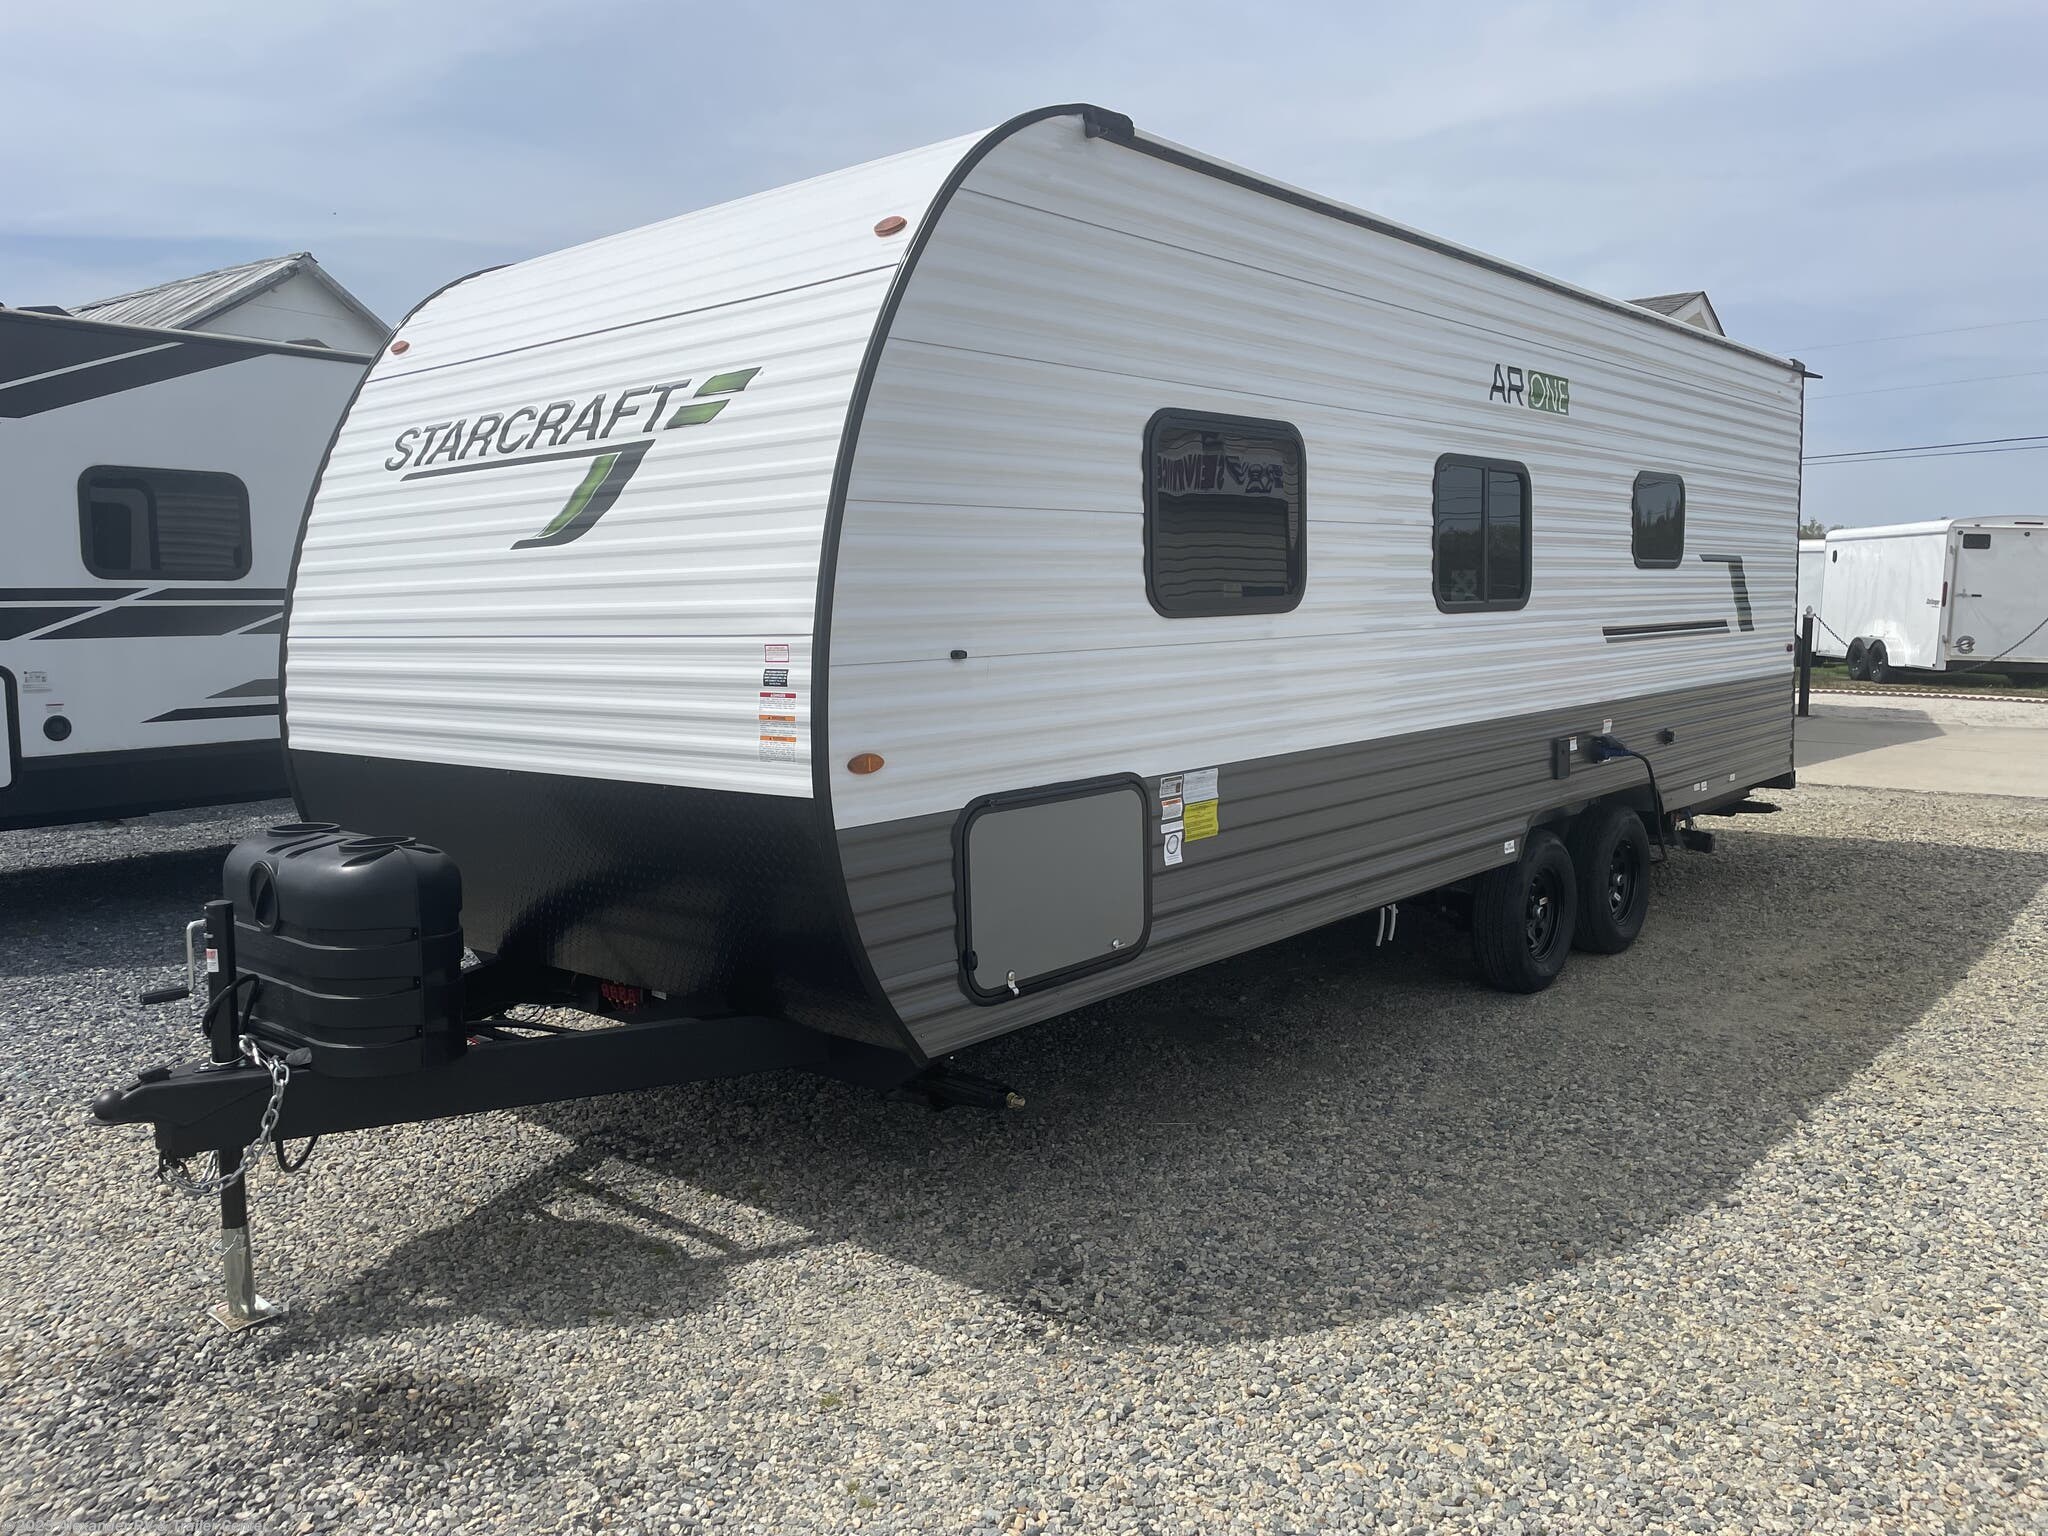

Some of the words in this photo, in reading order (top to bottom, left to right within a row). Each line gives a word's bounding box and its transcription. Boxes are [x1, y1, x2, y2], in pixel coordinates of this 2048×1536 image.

[1489, 363, 1525, 407] AR
[1530, 373, 1568, 413] ONE
[385, 378, 692, 471] STARCRAFT
